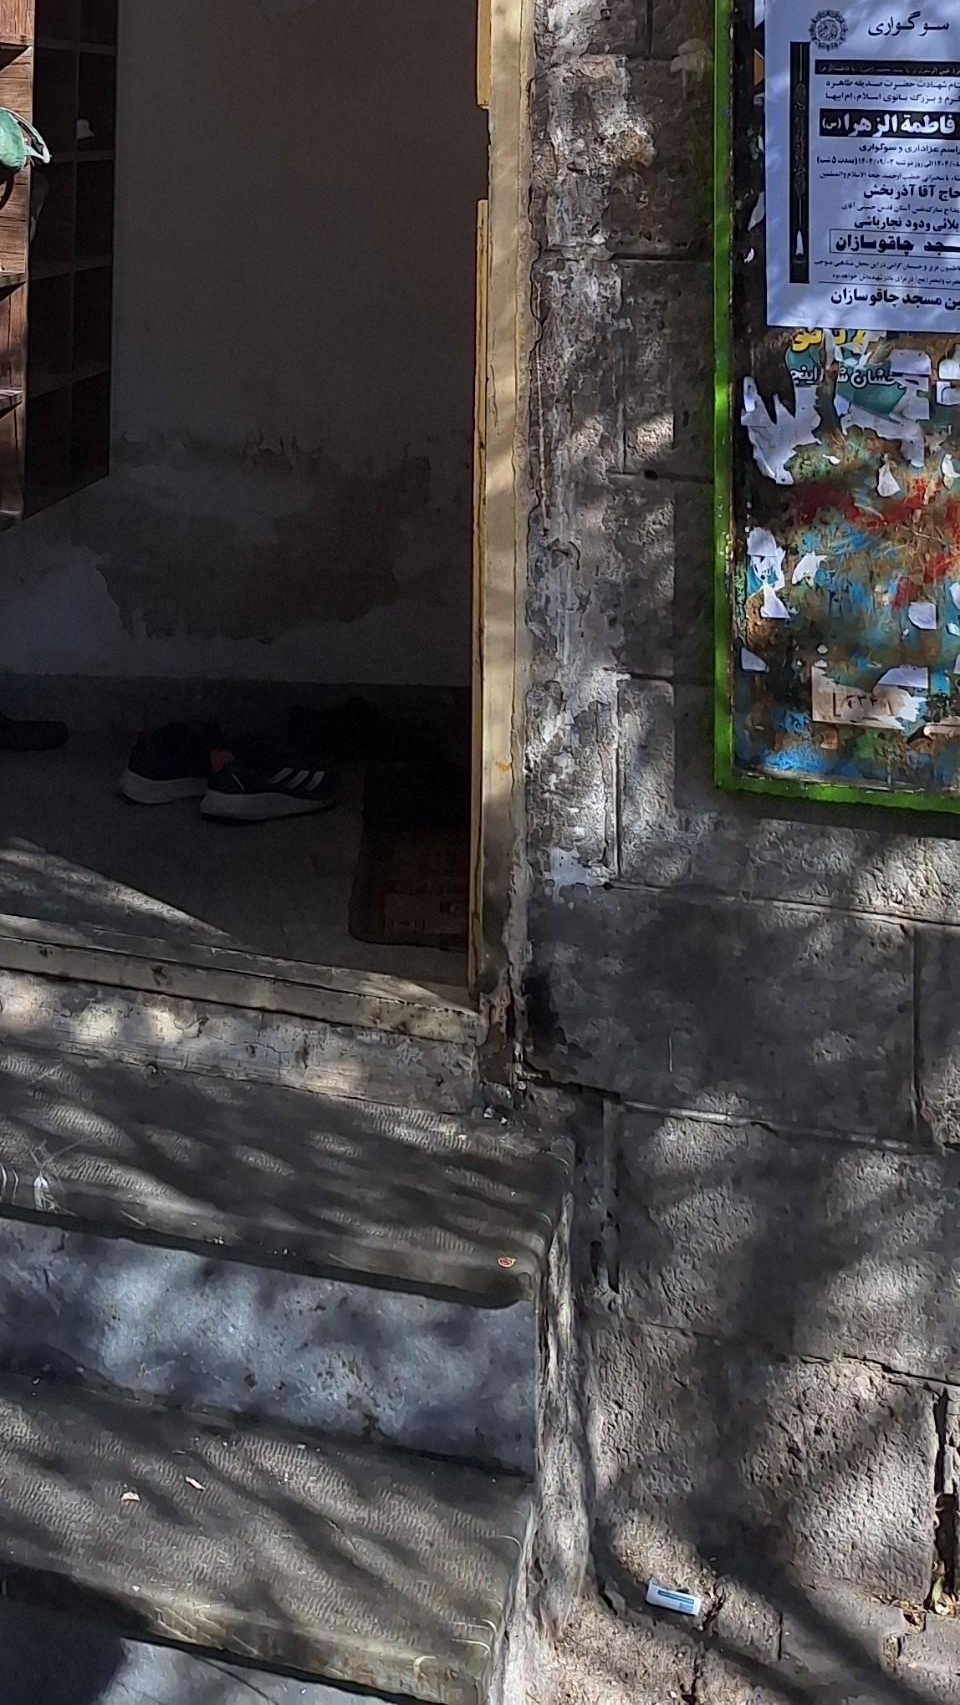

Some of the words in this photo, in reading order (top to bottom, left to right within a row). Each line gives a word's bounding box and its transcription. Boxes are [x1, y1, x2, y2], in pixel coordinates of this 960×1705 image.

[867, 10, 950, 37] سوگواری
[842, 112, 899, 138] الزهرا
[918, 184, 936, 198] آقا
[830, 287, 900, 308] چاقوسازان
[902, 292, 942, 309] مسجد
